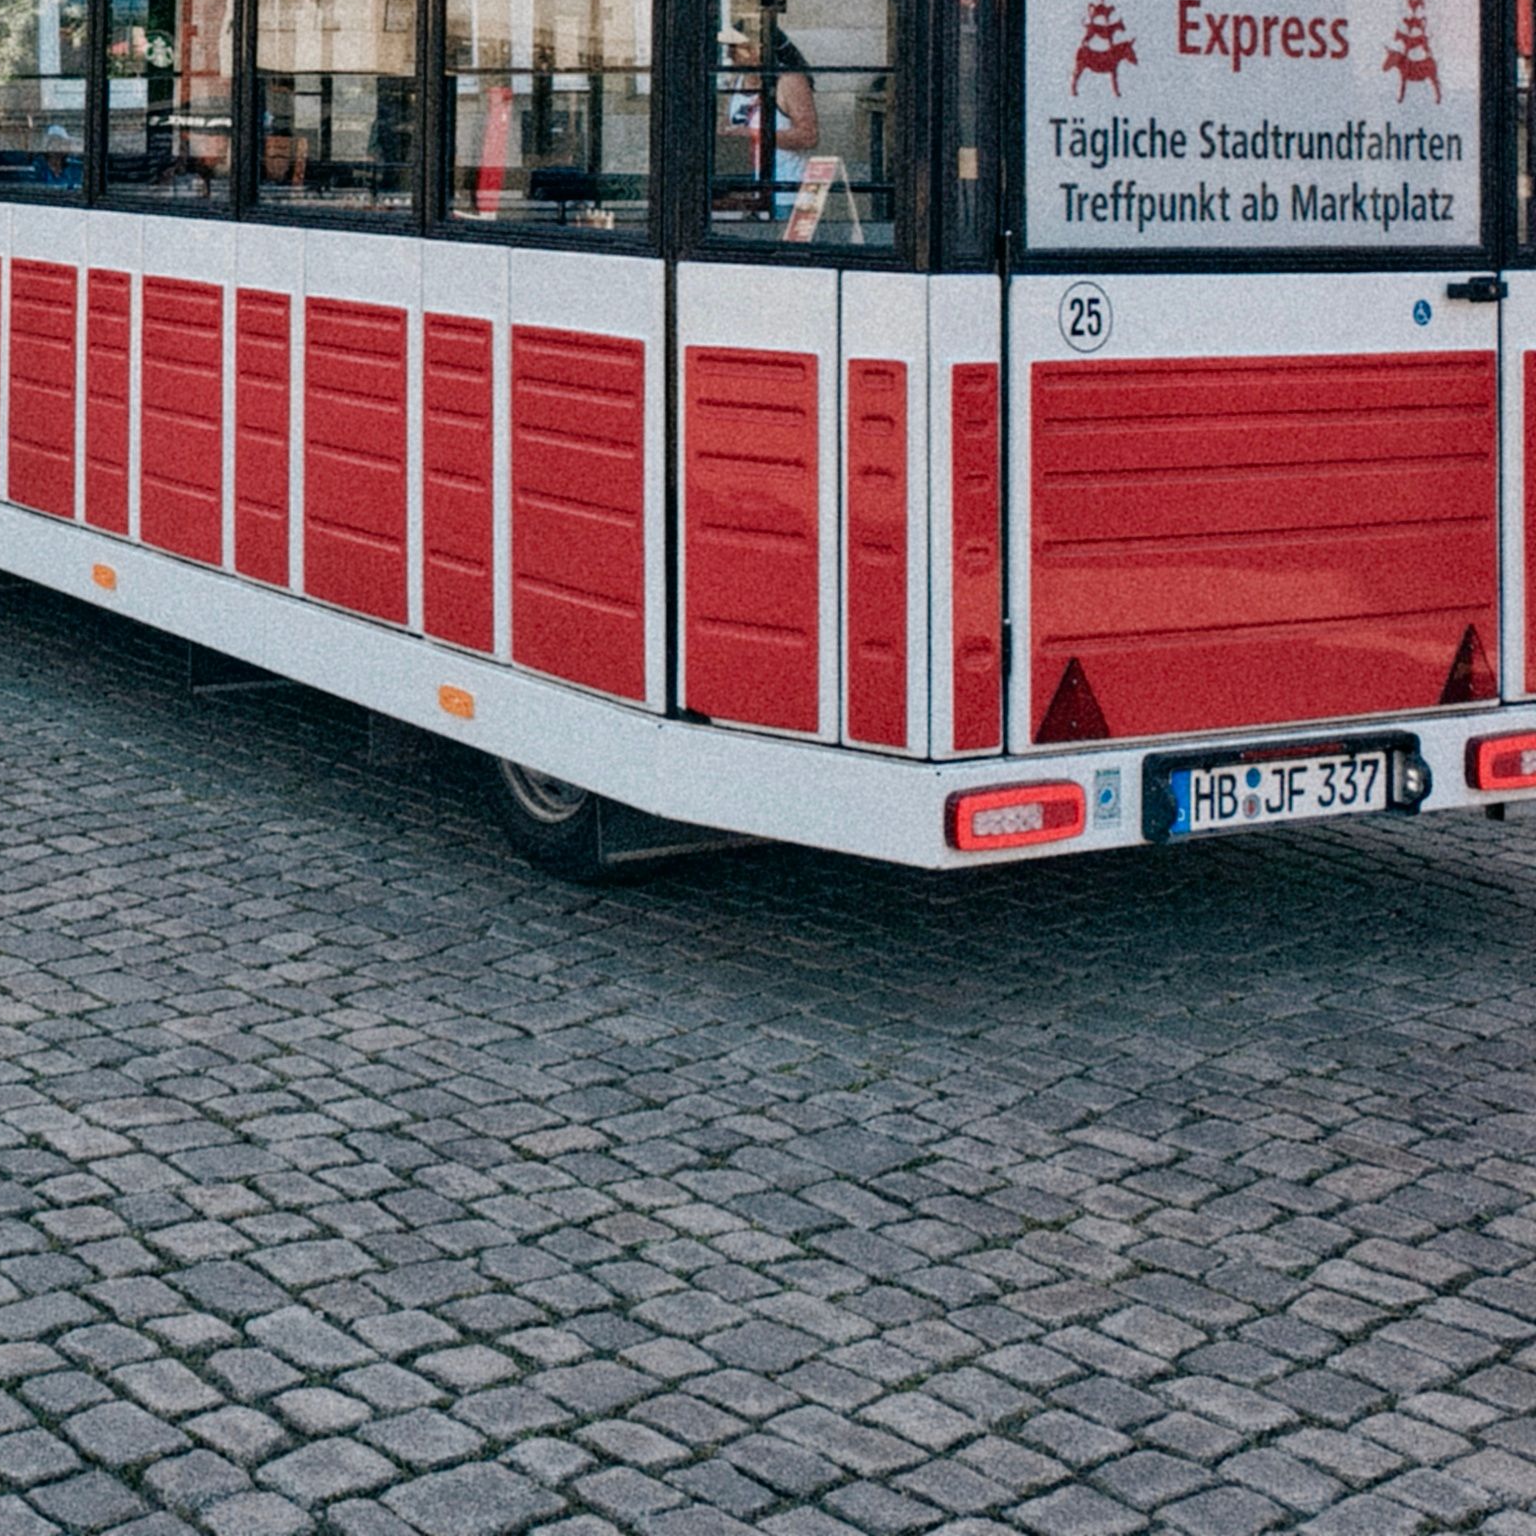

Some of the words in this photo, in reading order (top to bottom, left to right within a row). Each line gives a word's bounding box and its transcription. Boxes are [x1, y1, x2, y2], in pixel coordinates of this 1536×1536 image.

[1048, 117, 1188, 170] Tägliche
[1199, 120, 1463, 163] Stadtrundfahrten
[1059, 180, 1231, 234] Treffpunkt
[1241, 182, 1280, 222] ab
[1291, 182, 1455, 233] Marktplatz
[1068, 296, 1104, 337] 25
[1194, 771, 1238, 823] HB
[1265, 767, 1307, 815] JF
[1317, 758, 1380, 808] 337
